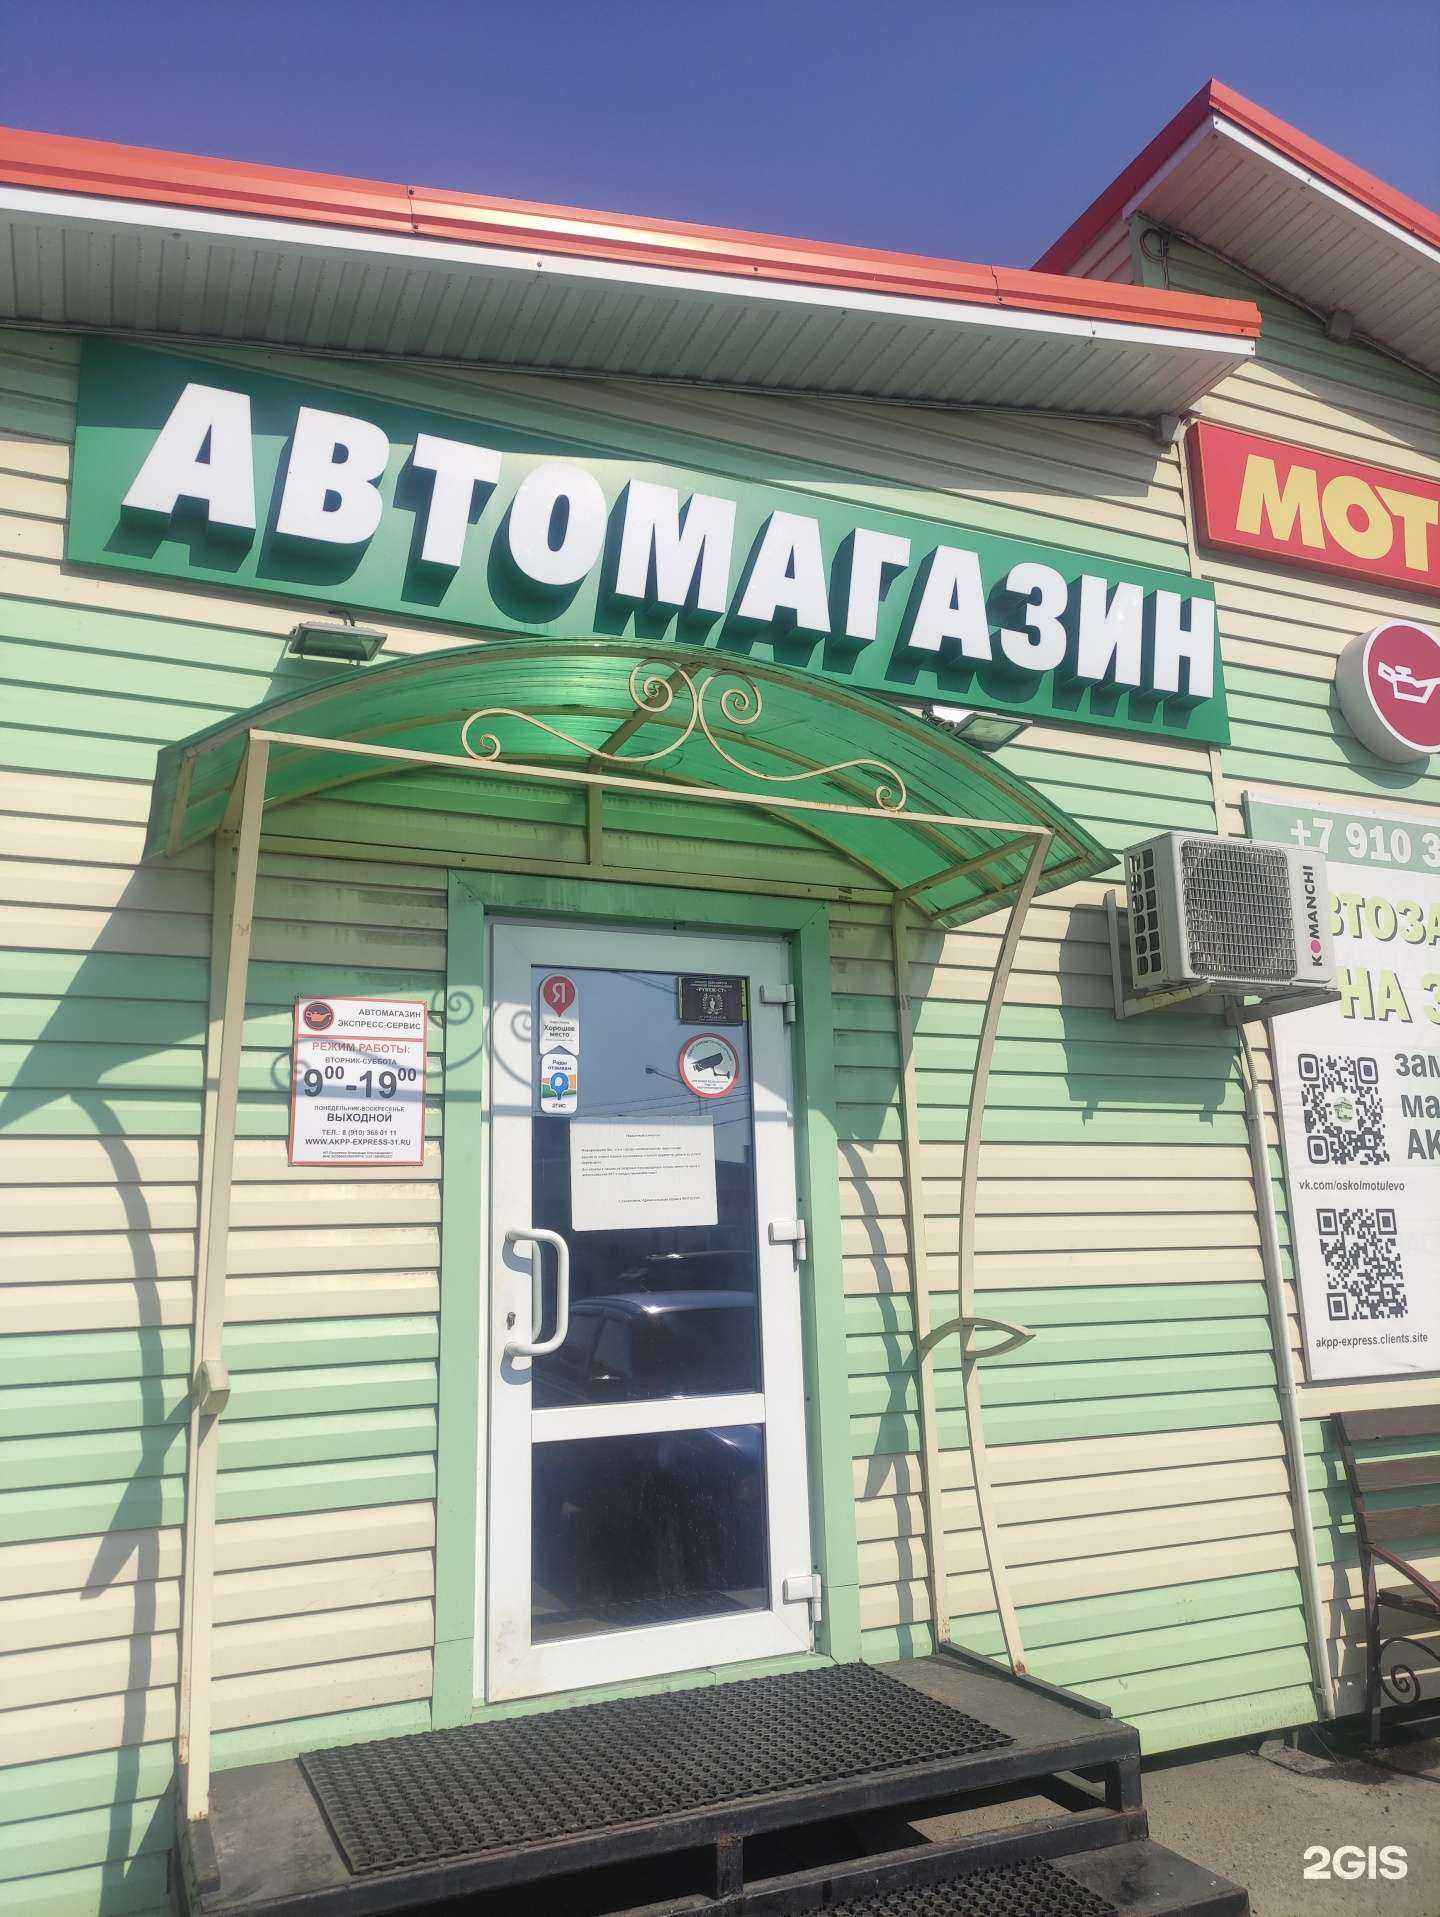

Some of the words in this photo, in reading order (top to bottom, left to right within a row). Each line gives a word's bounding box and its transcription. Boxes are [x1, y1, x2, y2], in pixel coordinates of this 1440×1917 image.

[121, 382, 1217, 699] АВТОМАГАЗИН
[1290, 817, 1335, 854] +7
[1345, 822, 1412, 864] 910
[1302, 865, 1324, 967] KOMANCHI
[552, 982, 566, 1004] Я
[1338, 966, 1413, 1024] НА
[358, 1008, 422, 1018] АВТОМАГАЗИН
[337, 1019, 421, 1030] ЭКСПРЕСС-СЕРВИС
[543, 1024, 575, 1033] Хорошее
[312, 1041, 356, 1052] РЕЖИМ
[358, 1043, 411, 1054] РАБОТЫ:
[325, 1057, 398, 1066] ВТОРНИК-СУББОТА
[327, 1112, 392, 1123] ВЫХОДНОЙ
[1299, 1178, 1406, 1192] vk.com/oskolmotulevo
[1315, 1333, 1429, 1350] akpp-express.clients.site
